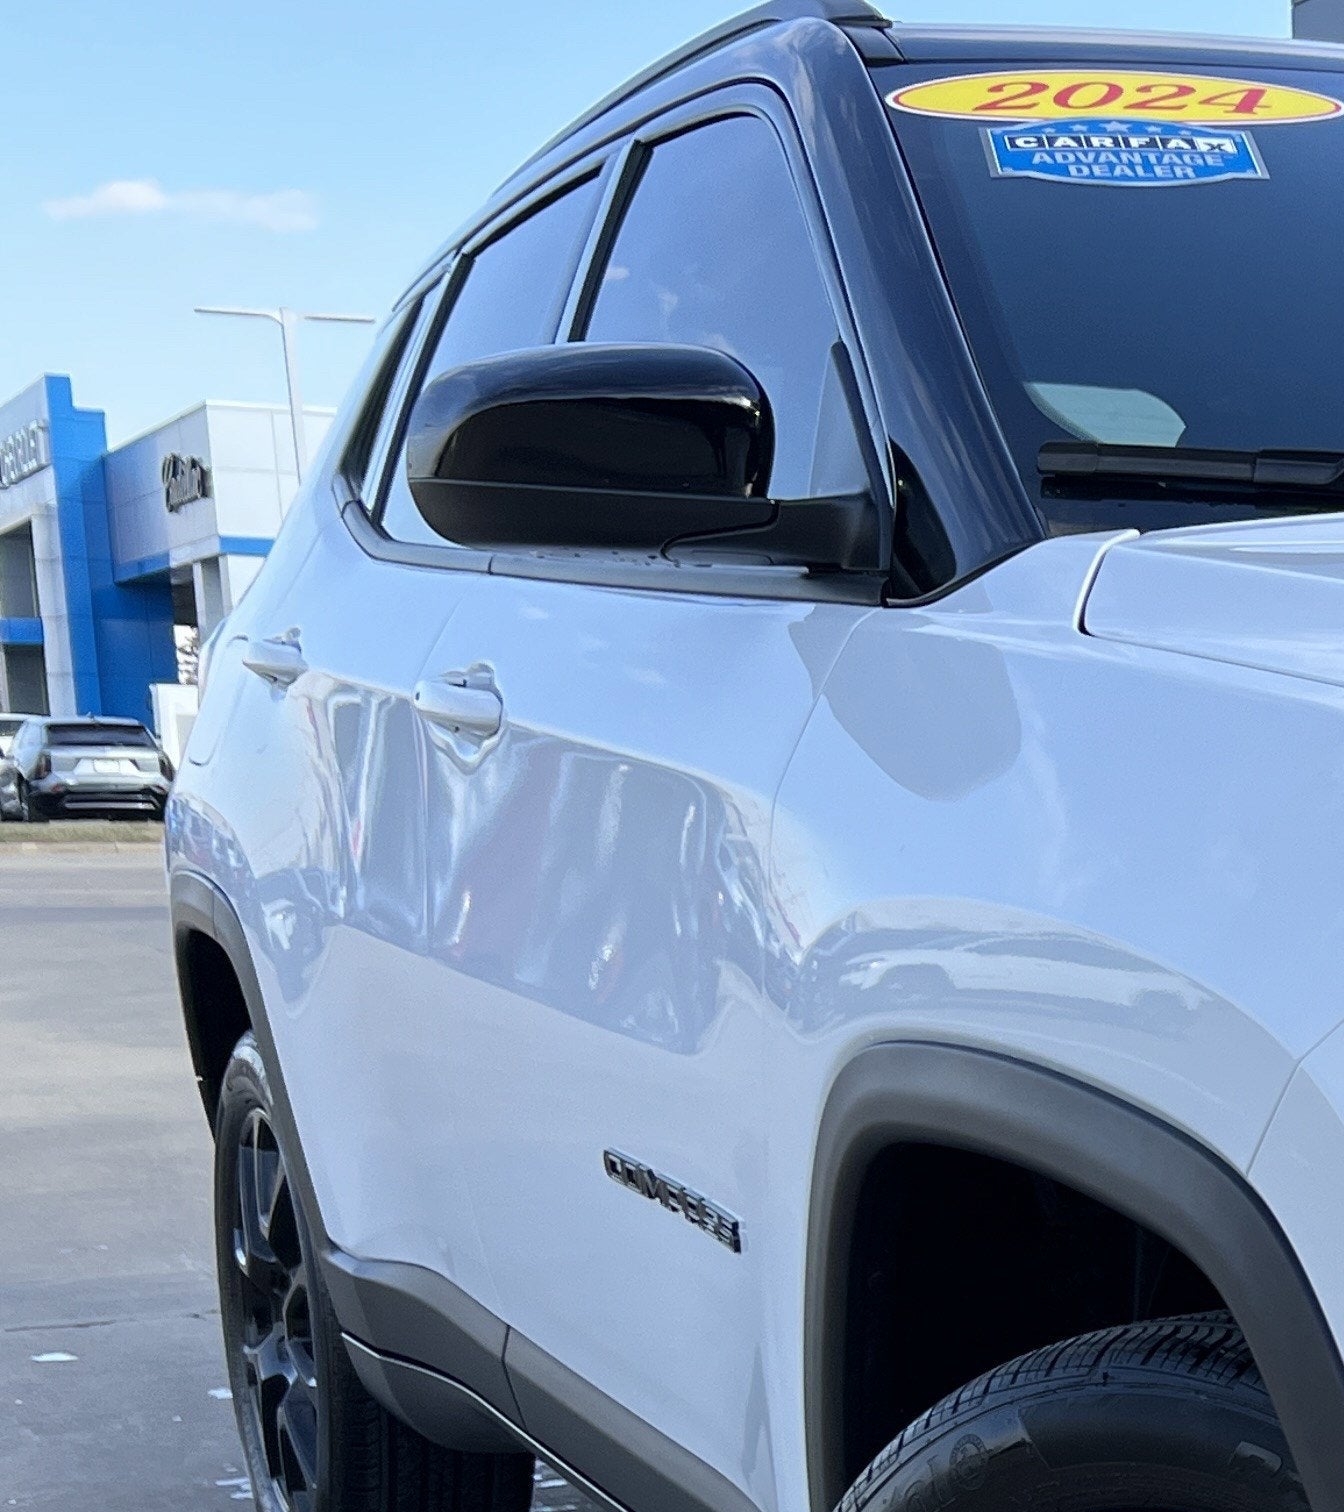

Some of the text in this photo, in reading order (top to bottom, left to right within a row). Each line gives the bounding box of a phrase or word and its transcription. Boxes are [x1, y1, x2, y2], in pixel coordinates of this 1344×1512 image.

[973, 81, 1276, 115] 2024
[1005, 134, 1236, 154] CARFAX
[1032, 151, 1223, 167] ADVANTAGE
[1068, 164, 1196, 179] DEALER
